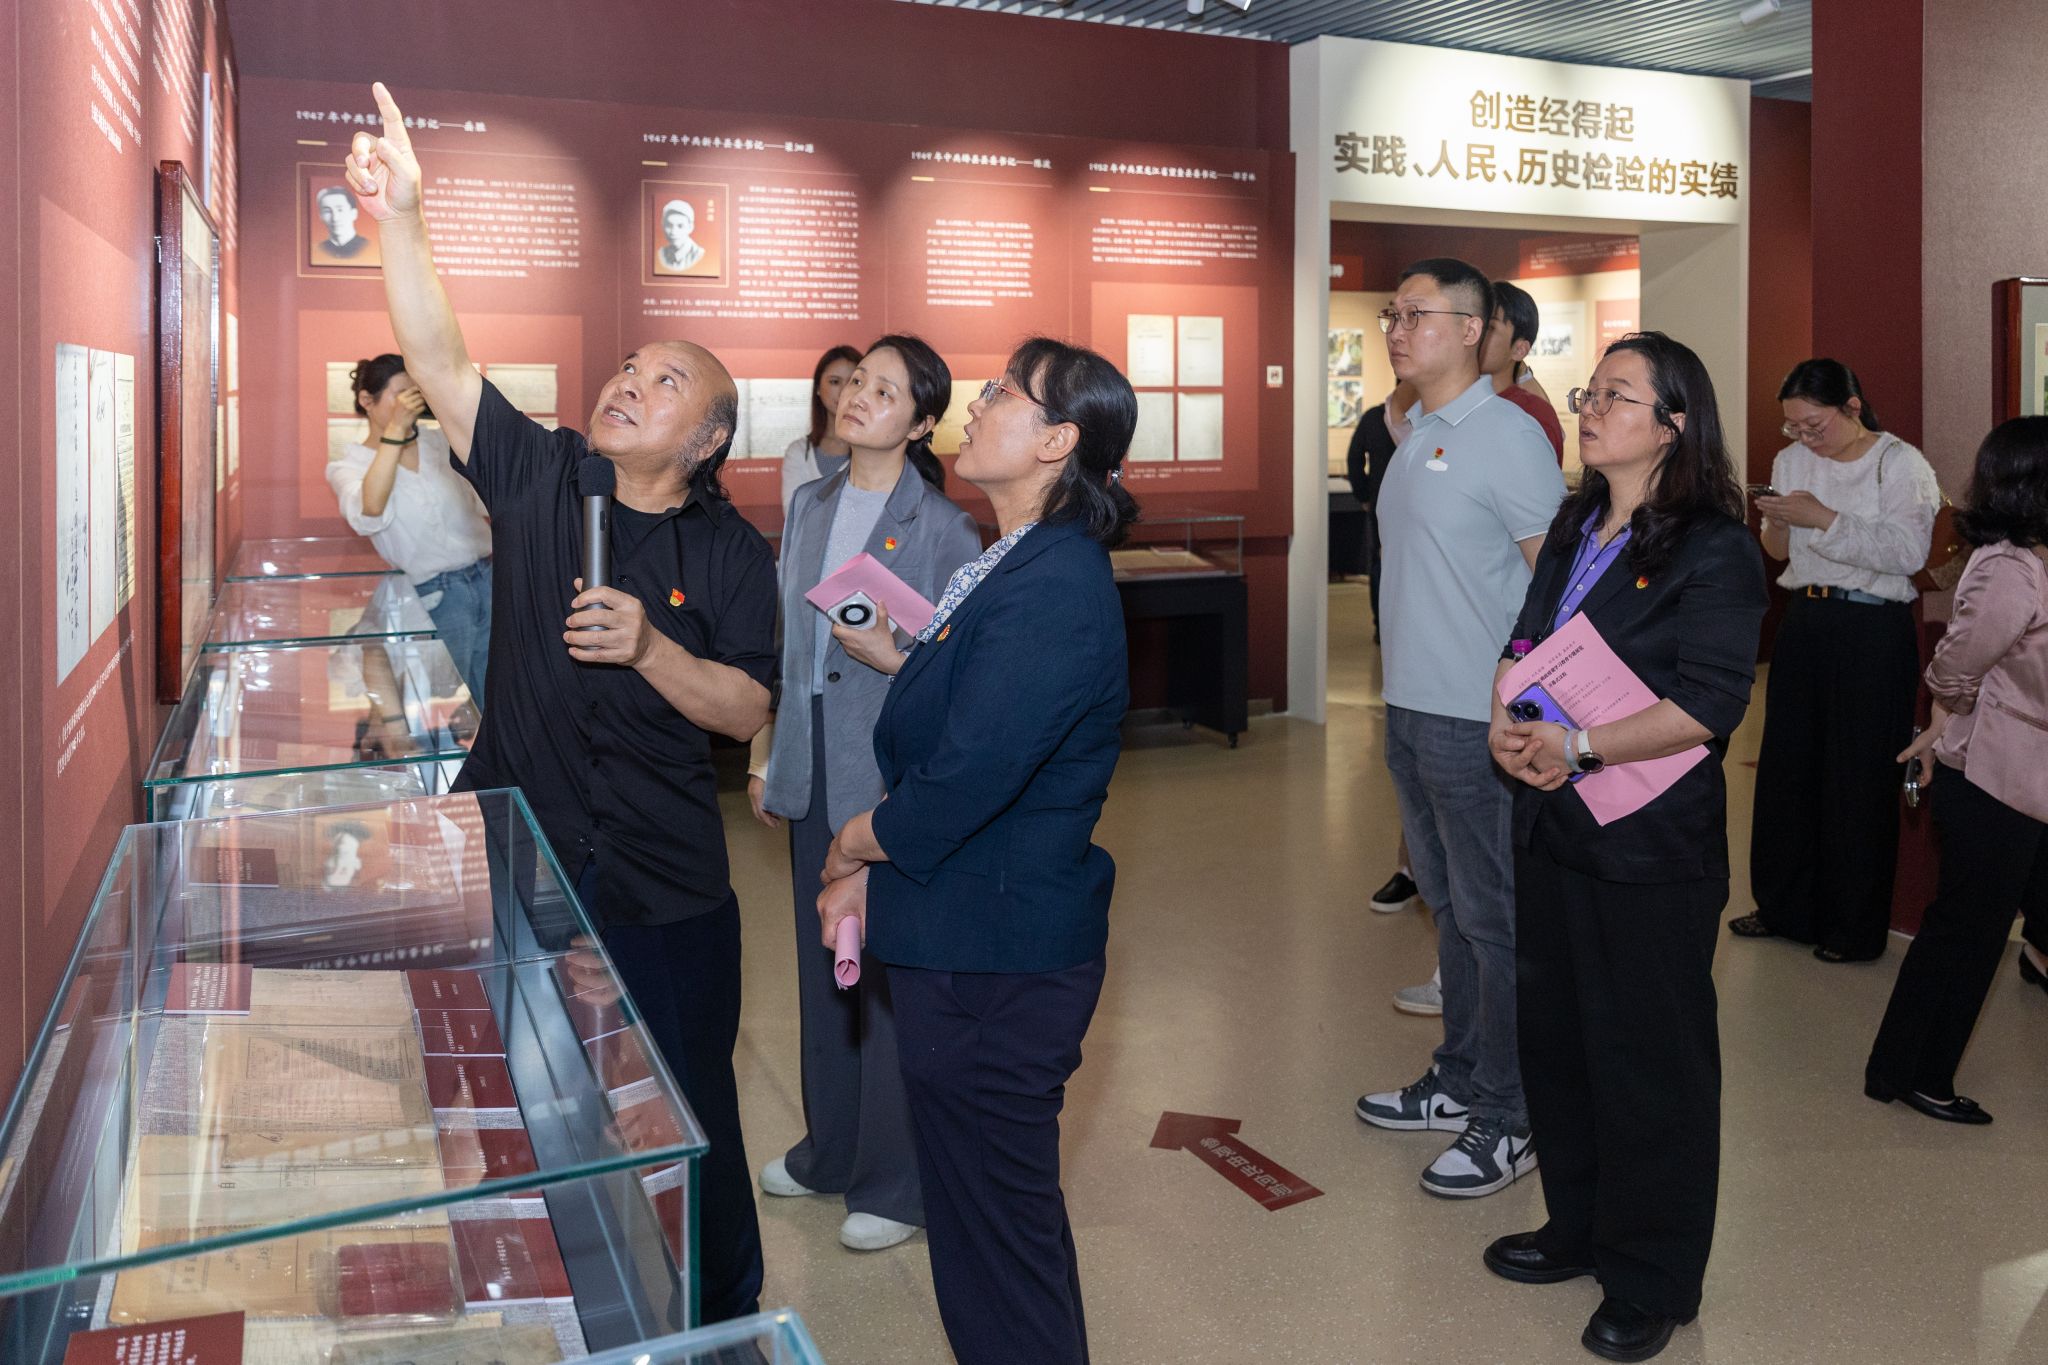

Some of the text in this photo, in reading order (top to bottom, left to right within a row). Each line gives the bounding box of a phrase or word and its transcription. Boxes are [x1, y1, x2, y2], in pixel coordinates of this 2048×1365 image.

[1470, 90, 1634, 142] 创造经得起
[1334, 132, 1739, 200] 实践、人民、历史检验的实绩
[1200, 1137, 1293, 1197] 参观由此向前
